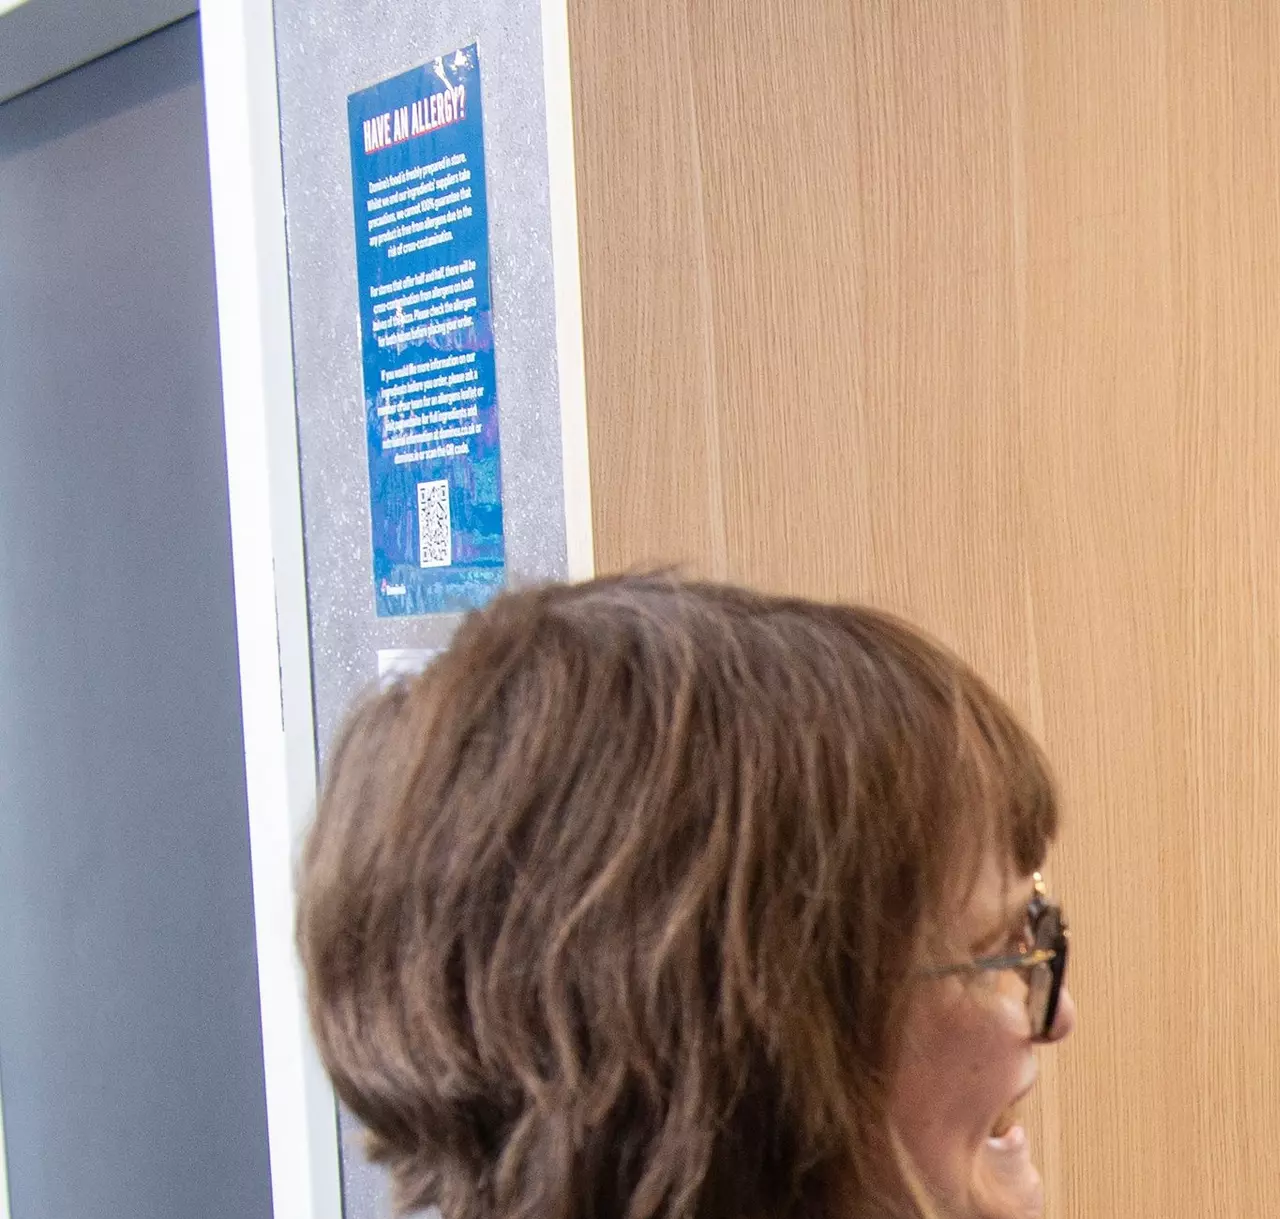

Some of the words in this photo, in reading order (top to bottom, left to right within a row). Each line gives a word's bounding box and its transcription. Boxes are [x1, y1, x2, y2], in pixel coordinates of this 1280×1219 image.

[363, 114, 391, 152] HAVE
[393, 105, 409, 142] AN
[410, 84, 466, 137] ALLERGY?
